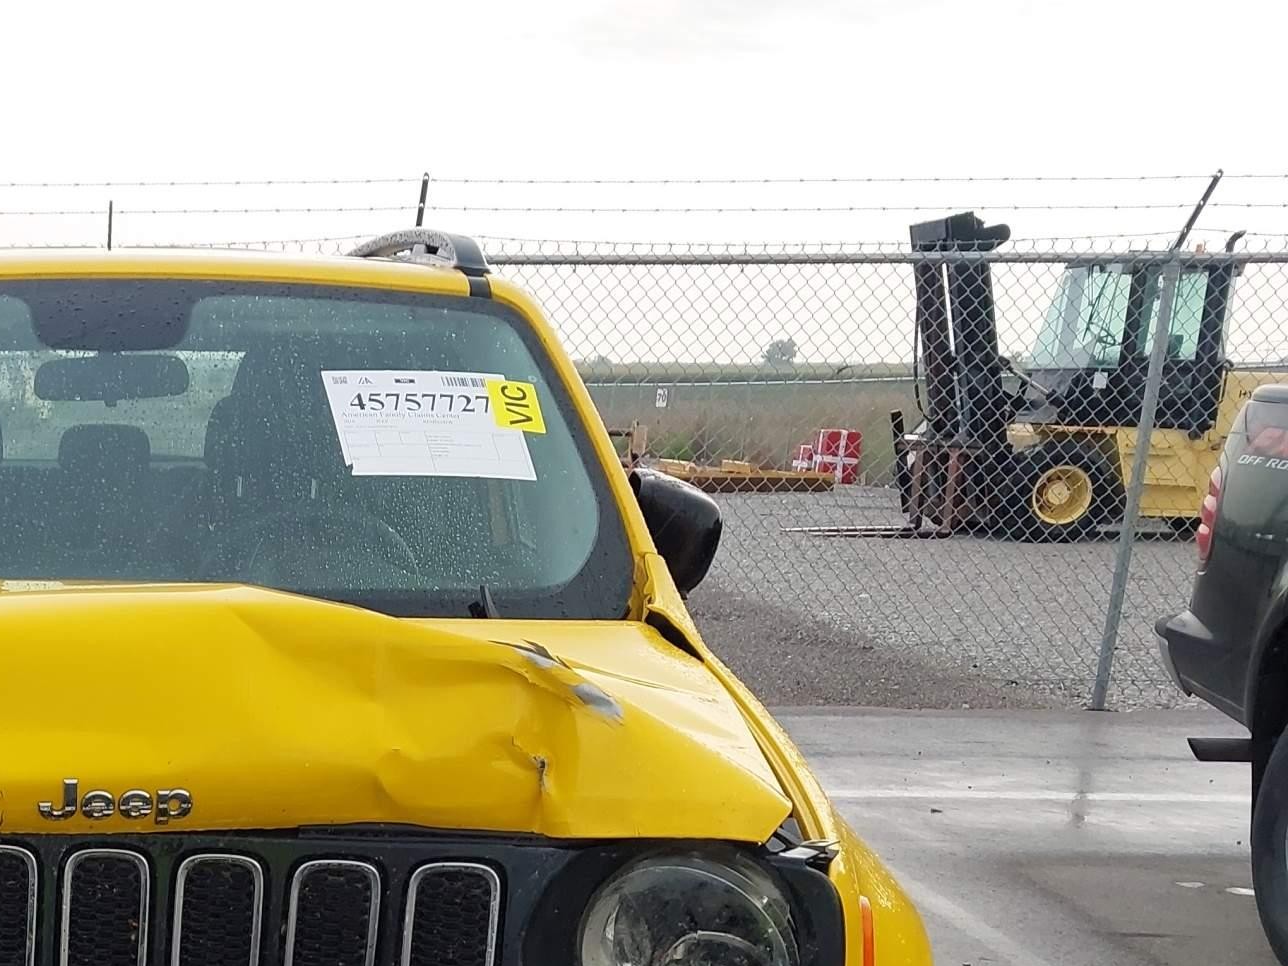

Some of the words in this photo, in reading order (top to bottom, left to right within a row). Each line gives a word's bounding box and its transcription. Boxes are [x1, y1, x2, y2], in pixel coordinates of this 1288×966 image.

[350, 392, 489, 413] 45757727
[500, 385, 533, 425] VIC
[1237, 454, 1265, 465] OFF
[37, 778, 193, 825] Jeep
